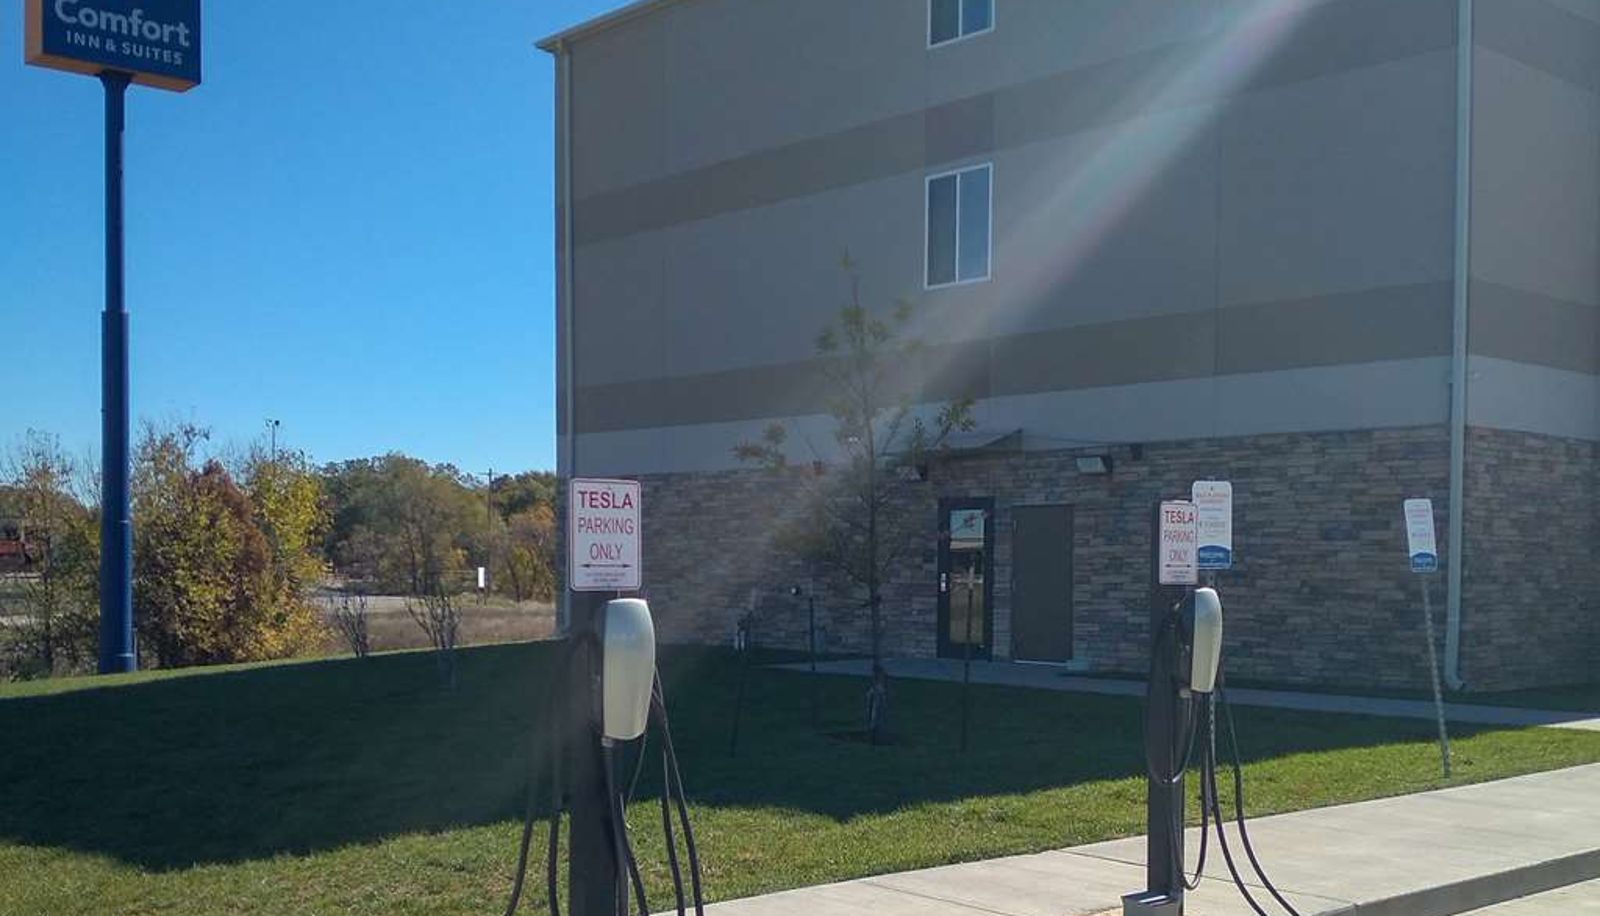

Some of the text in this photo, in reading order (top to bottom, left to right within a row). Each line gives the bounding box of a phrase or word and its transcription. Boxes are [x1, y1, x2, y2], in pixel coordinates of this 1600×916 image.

[55, 0, 190, 47] Comfort
[66, 30, 184, 65] INN & SUITES
[578, 490, 634, 509] TESLA
[578, 517, 634, 535] PARKING
[1165, 510, 1194, 524] TESLA
[590, 543, 623, 560] ONLY
